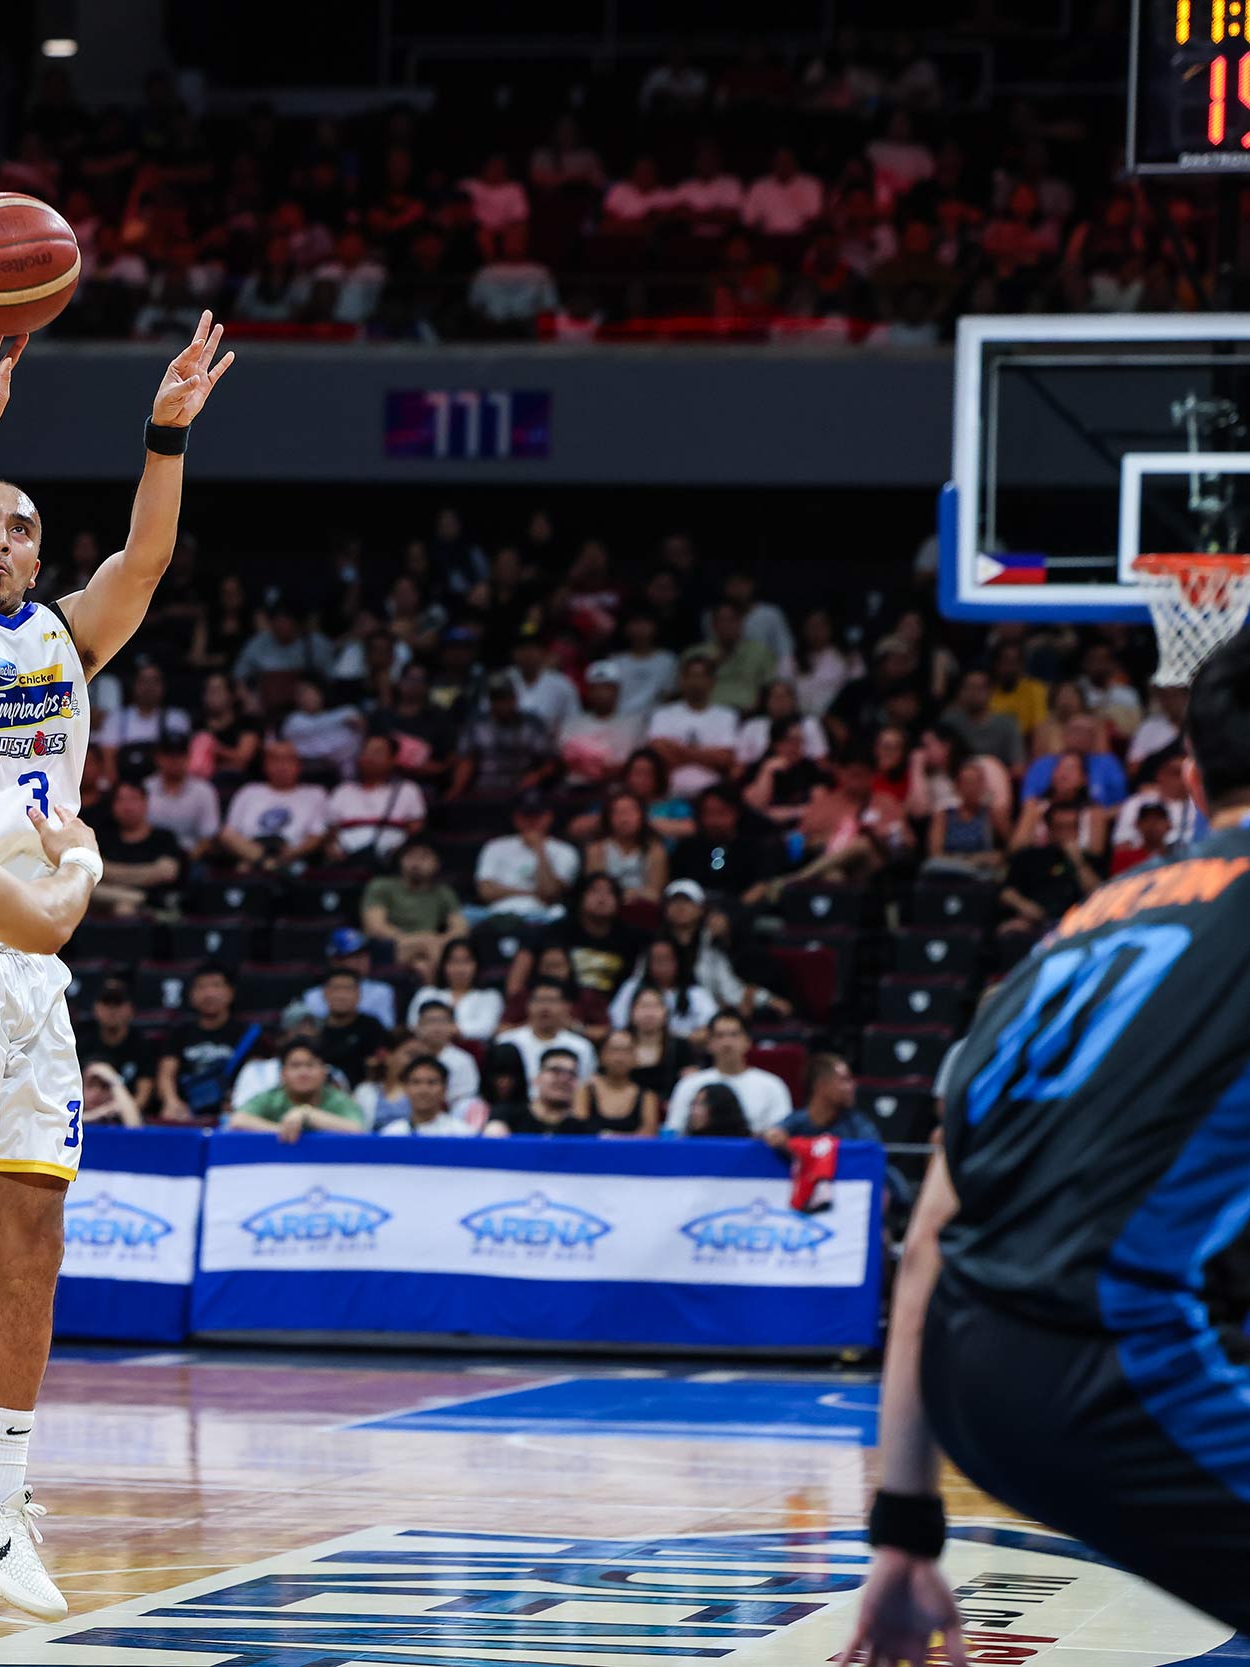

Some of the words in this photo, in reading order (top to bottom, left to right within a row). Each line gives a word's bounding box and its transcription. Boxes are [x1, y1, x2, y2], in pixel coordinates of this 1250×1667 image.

[1176, 0, 1250, 45] 11:
[17, 770, 49, 819] 3
[63, 1100, 81, 1148] 3
[64, 1217, 158, 1247] RENA
[256, 1211, 377, 1241] ARENA
[475, 1216, 596, 1248] ARENA
[696, 1222, 819, 1253] ARENA
